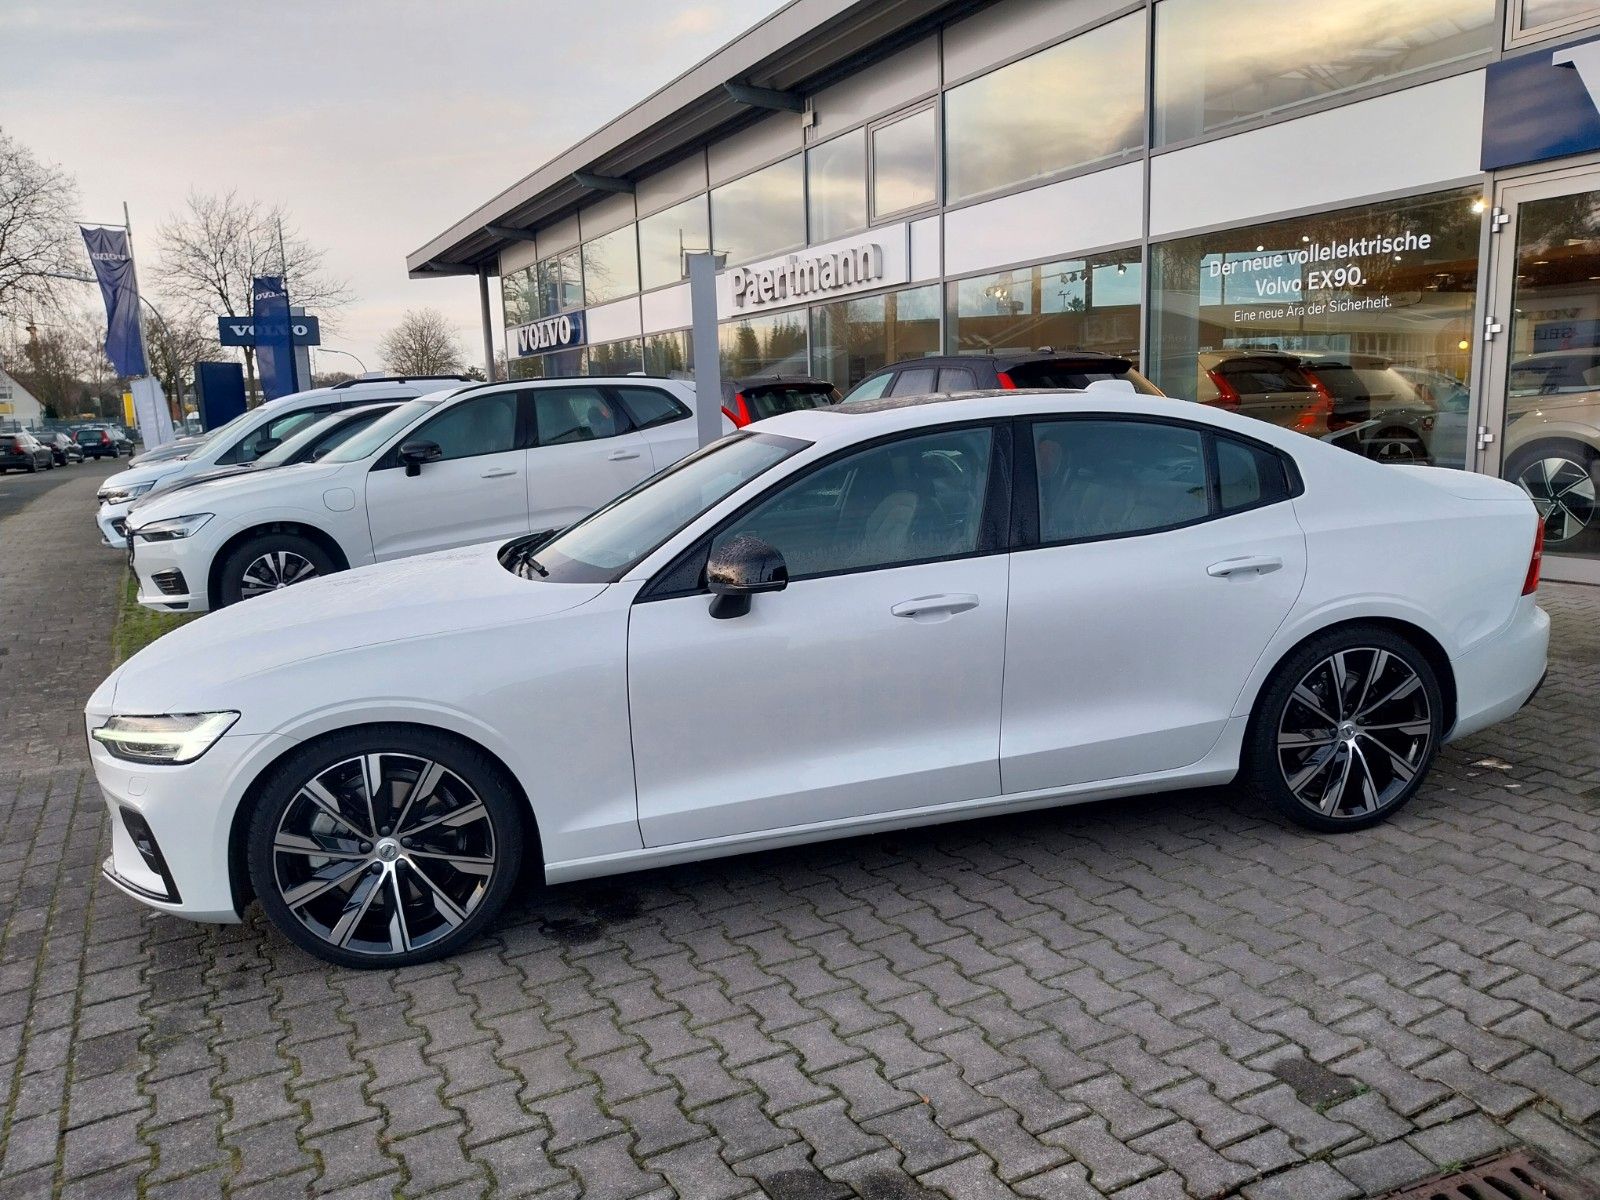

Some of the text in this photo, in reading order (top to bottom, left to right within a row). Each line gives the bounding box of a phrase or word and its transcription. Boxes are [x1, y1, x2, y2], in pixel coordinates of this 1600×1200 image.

[1209, 230, 1432, 278] Der neue vollelektrische
[731, 243, 882, 307] Paertmann
[1255, 266, 1367, 297] Volvo EX90.
[1234, 295, 1393, 323] Eine neue Ära der Sicherheit.
[518, 315, 571, 352] VOLVO
